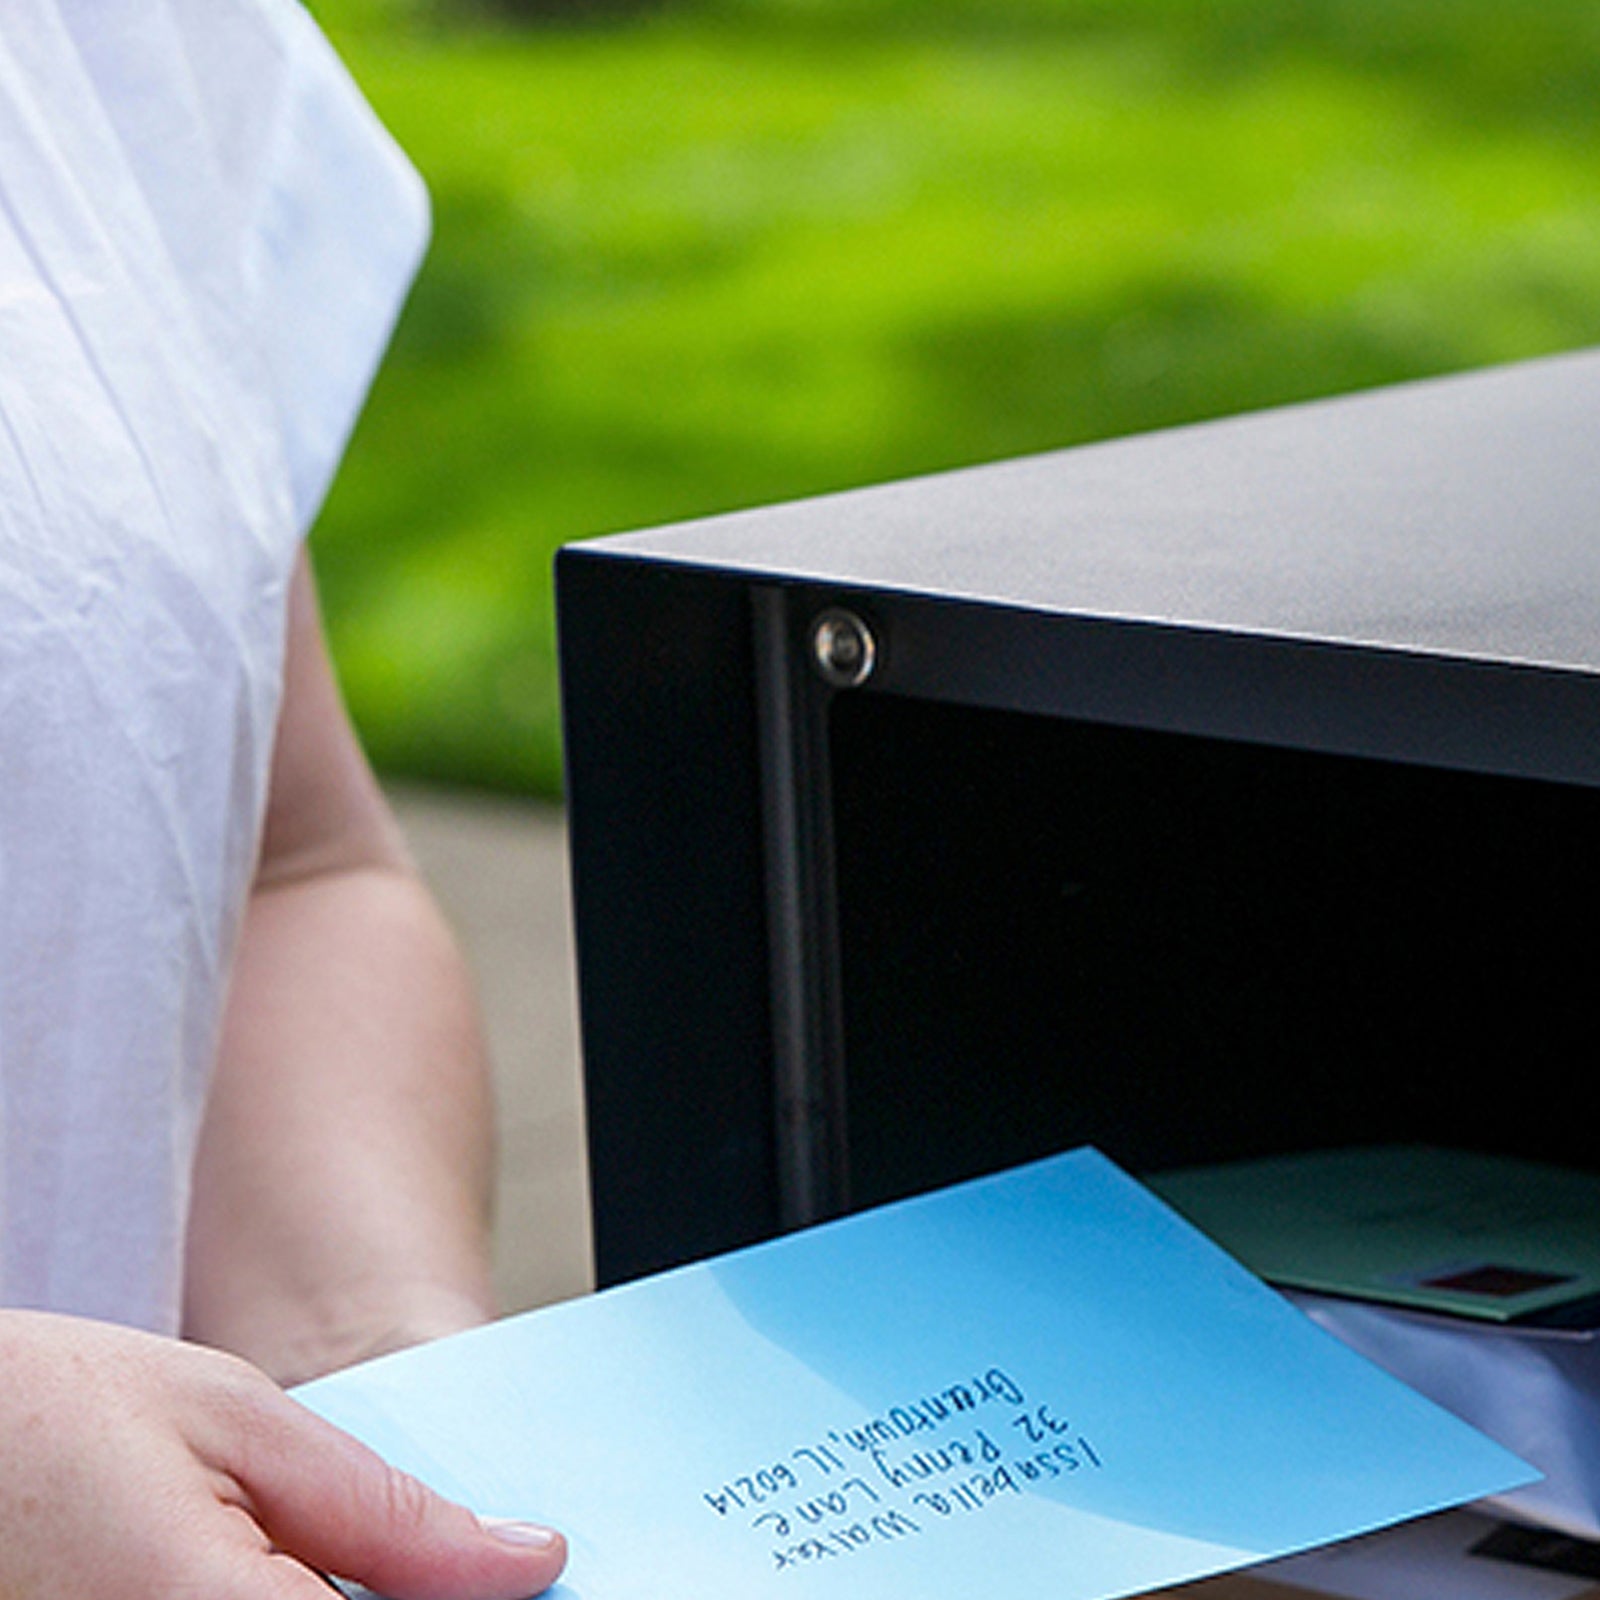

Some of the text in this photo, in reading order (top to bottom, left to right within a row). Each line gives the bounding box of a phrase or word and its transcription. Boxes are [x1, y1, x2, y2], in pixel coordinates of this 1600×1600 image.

[703, 1461, 799, 1516] 60214
[752, 1403, 1069, 1536] 32 Penny Lane
